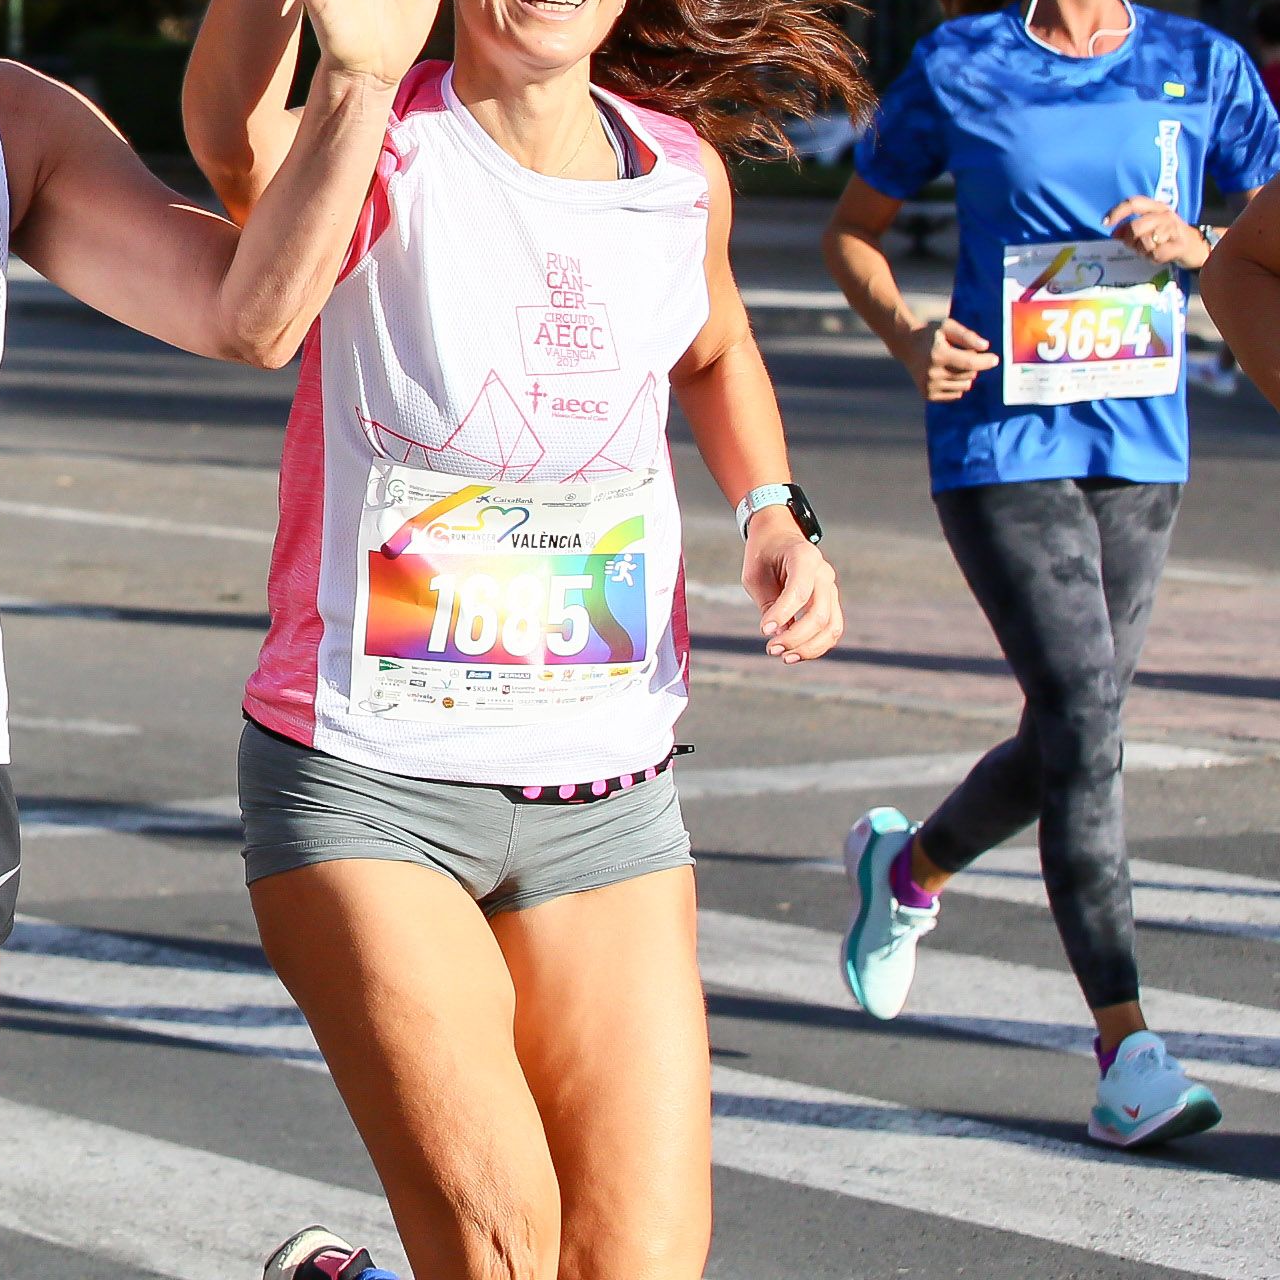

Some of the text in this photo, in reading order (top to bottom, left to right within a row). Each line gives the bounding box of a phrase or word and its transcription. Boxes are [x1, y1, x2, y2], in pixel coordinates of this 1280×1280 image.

[546, 252, 580, 273] RUN
[550, 290, 586, 309] CER
[544, 312, 595, 325] CIRCUITO
[533, 322, 604, 350] AECC
[1037, 306, 1152, 362] 3654
[544, 347, 596, 360] VALENCIA
[552, 398, 609, 414] aecc
[493, 496, 534, 505] CaixaBank
[511, 531, 582, 549] VALÈNCIA
[427, 573, 593, 658] 1685
